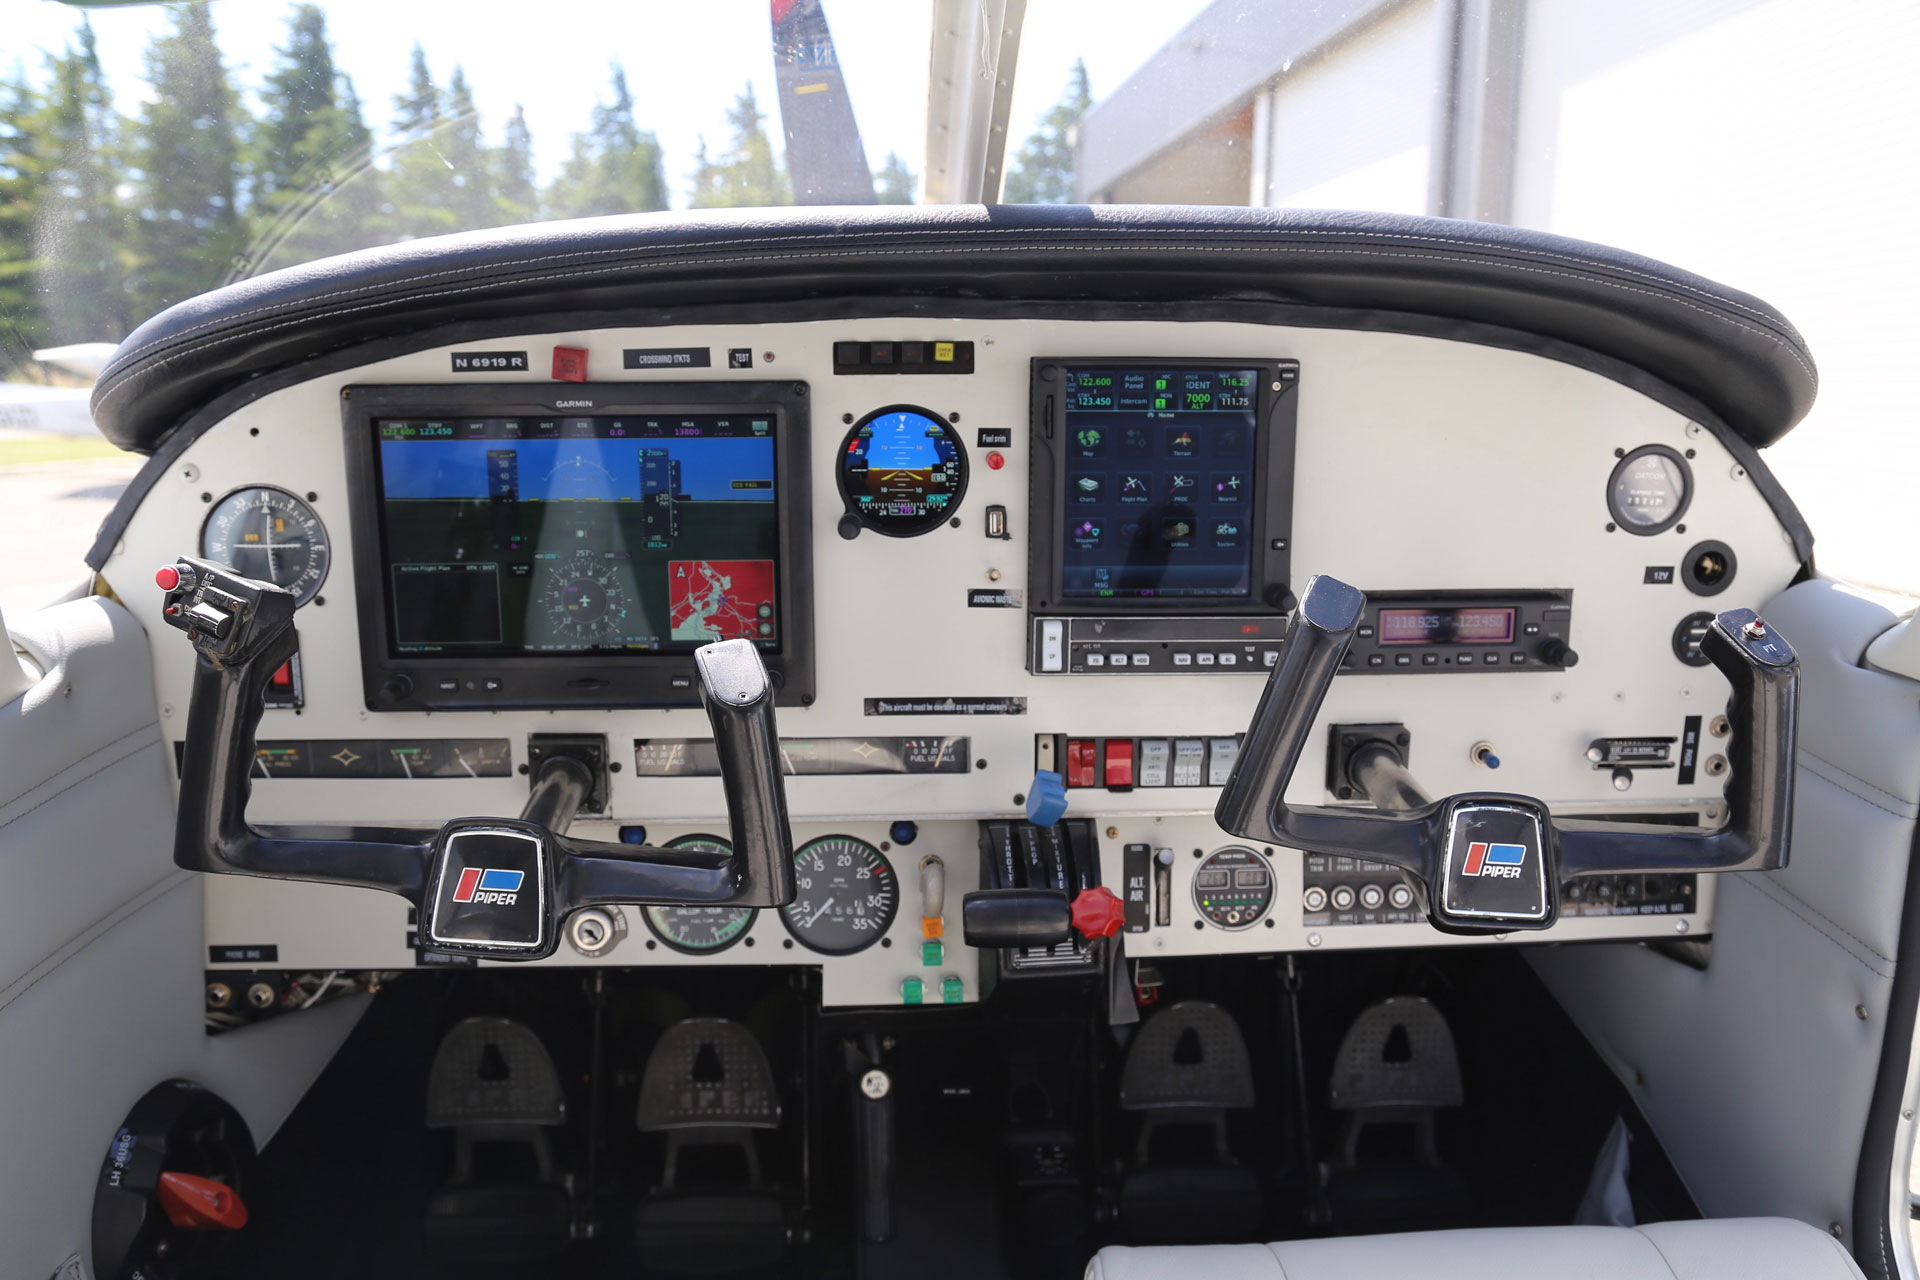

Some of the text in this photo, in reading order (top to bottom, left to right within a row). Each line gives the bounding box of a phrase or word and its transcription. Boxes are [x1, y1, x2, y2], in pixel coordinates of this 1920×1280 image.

[456, 357, 523, 368] N 6919 R
[639, 355, 672, 364] CROSSWIND
[735, 353, 750, 362] TEST
[1079, 377, 1112, 386] 122.600
[1186, 381, 1211, 390] IDENT
[1222, 377, 1250, 387] 116.25
[1078, 397, 1112, 406] 123.450
[1186, 393, 1211, 403] 7000
[1221, 397, 1249, 406] 111.75
[556, 400, 593, 408] GARMIN
[419, 427, 453, 435] 123.450
[203, 572, 215, 582] A/P
[1654, 570, 1670, 581] 12V
[973, 594, 995, 604] AVIONIC
[882, 703, 893, 711] This
[893, 703, 912, 711] aircraft
[912, 703, 926, 711] must
[926, 703, 933, 711] be
[968, 703, 986, 712] normal
[910, 755, 927, 763] FUEL
[1029, 840, 1039, 866] PROP
[813, 860, 825, 872] 15
[837, 855, 851, 867] 20
[1051, 838, 1065, 890] MIXTURE
[856, 867, 871, 880] 25
[1481, 865, 1522, 879] PIPER
[801, 878, 812, 889] 10
[1129, 876, 1146, 889] ALT.
[474, 890, 518, 906] PIPER
[1129, 889, 1144, 902] AIR
[803, 901, 810, 913] 5
[867, 895, 882, 908] 30
[852, 918, 868, 930] 35
[109, 1134, 132, 1187] LH 36USG
